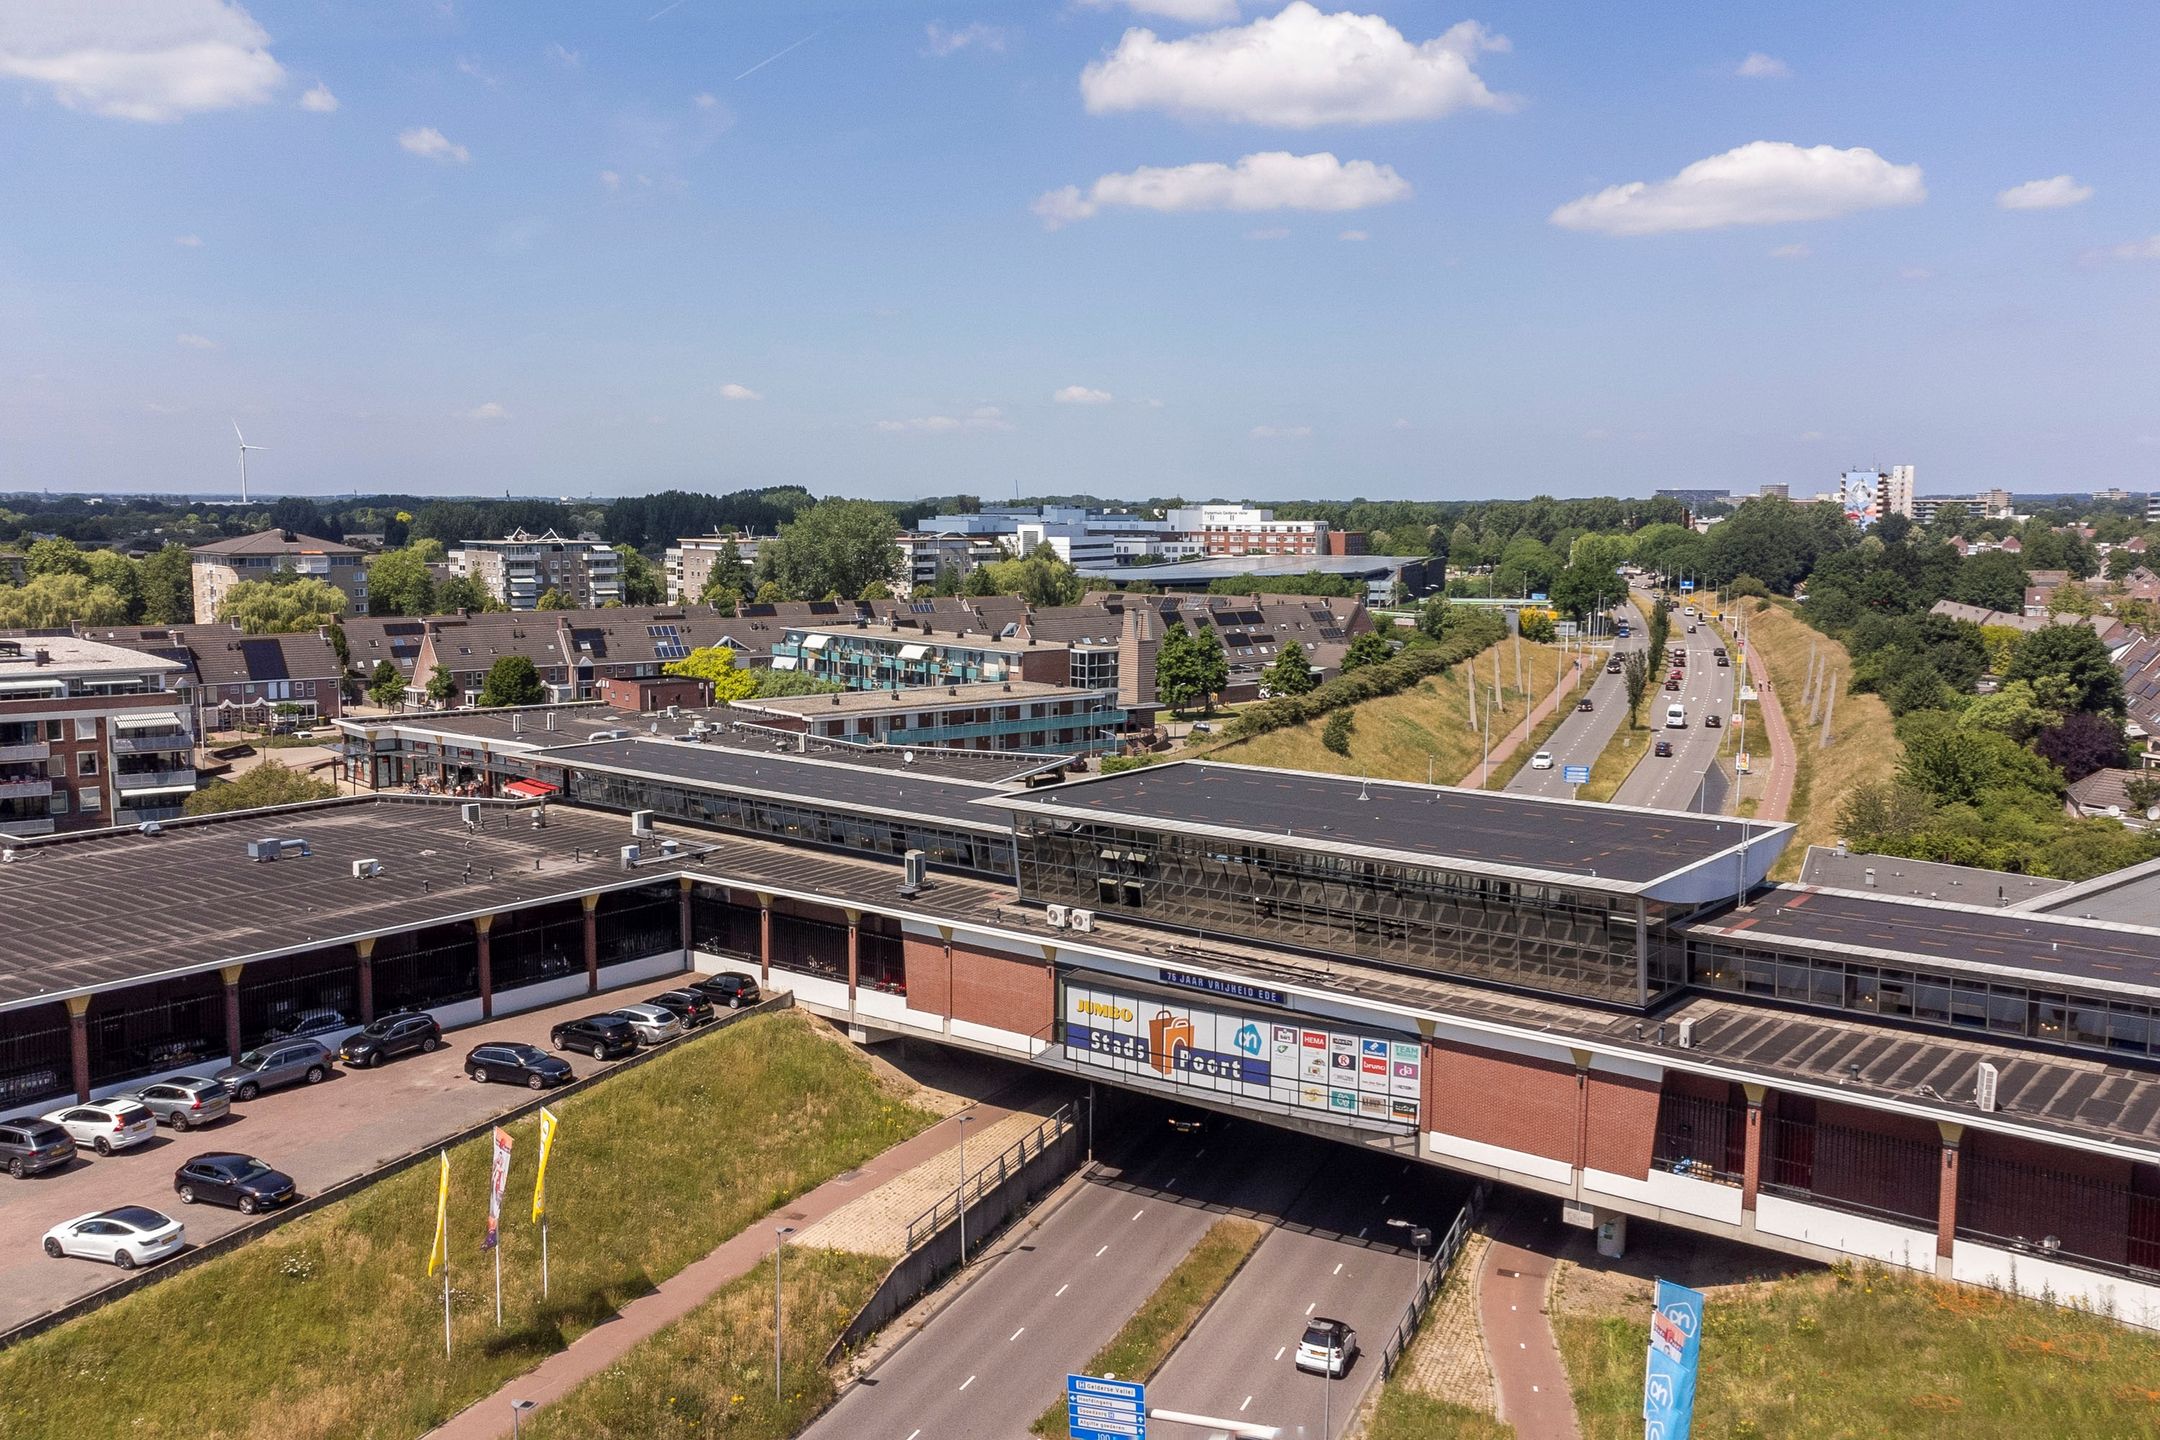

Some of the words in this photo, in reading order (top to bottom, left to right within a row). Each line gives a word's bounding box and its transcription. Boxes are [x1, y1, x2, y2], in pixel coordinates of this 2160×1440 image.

[1179, 974, 1204, 987] JAAR
[1207, 980, 1254, 996] VRIJHEID
[1258, 990, 1277, 1001] EDE
[1077, 1000, 1133, 1022] JUMBO
[1304, 1036, 1324, 1045] HEMA
[1091, 1031, 1144, 1058] Stads
[1179, 1050, 1241, 1078] Poort
[1087, 1384, 1113, 1392] Gelderse
